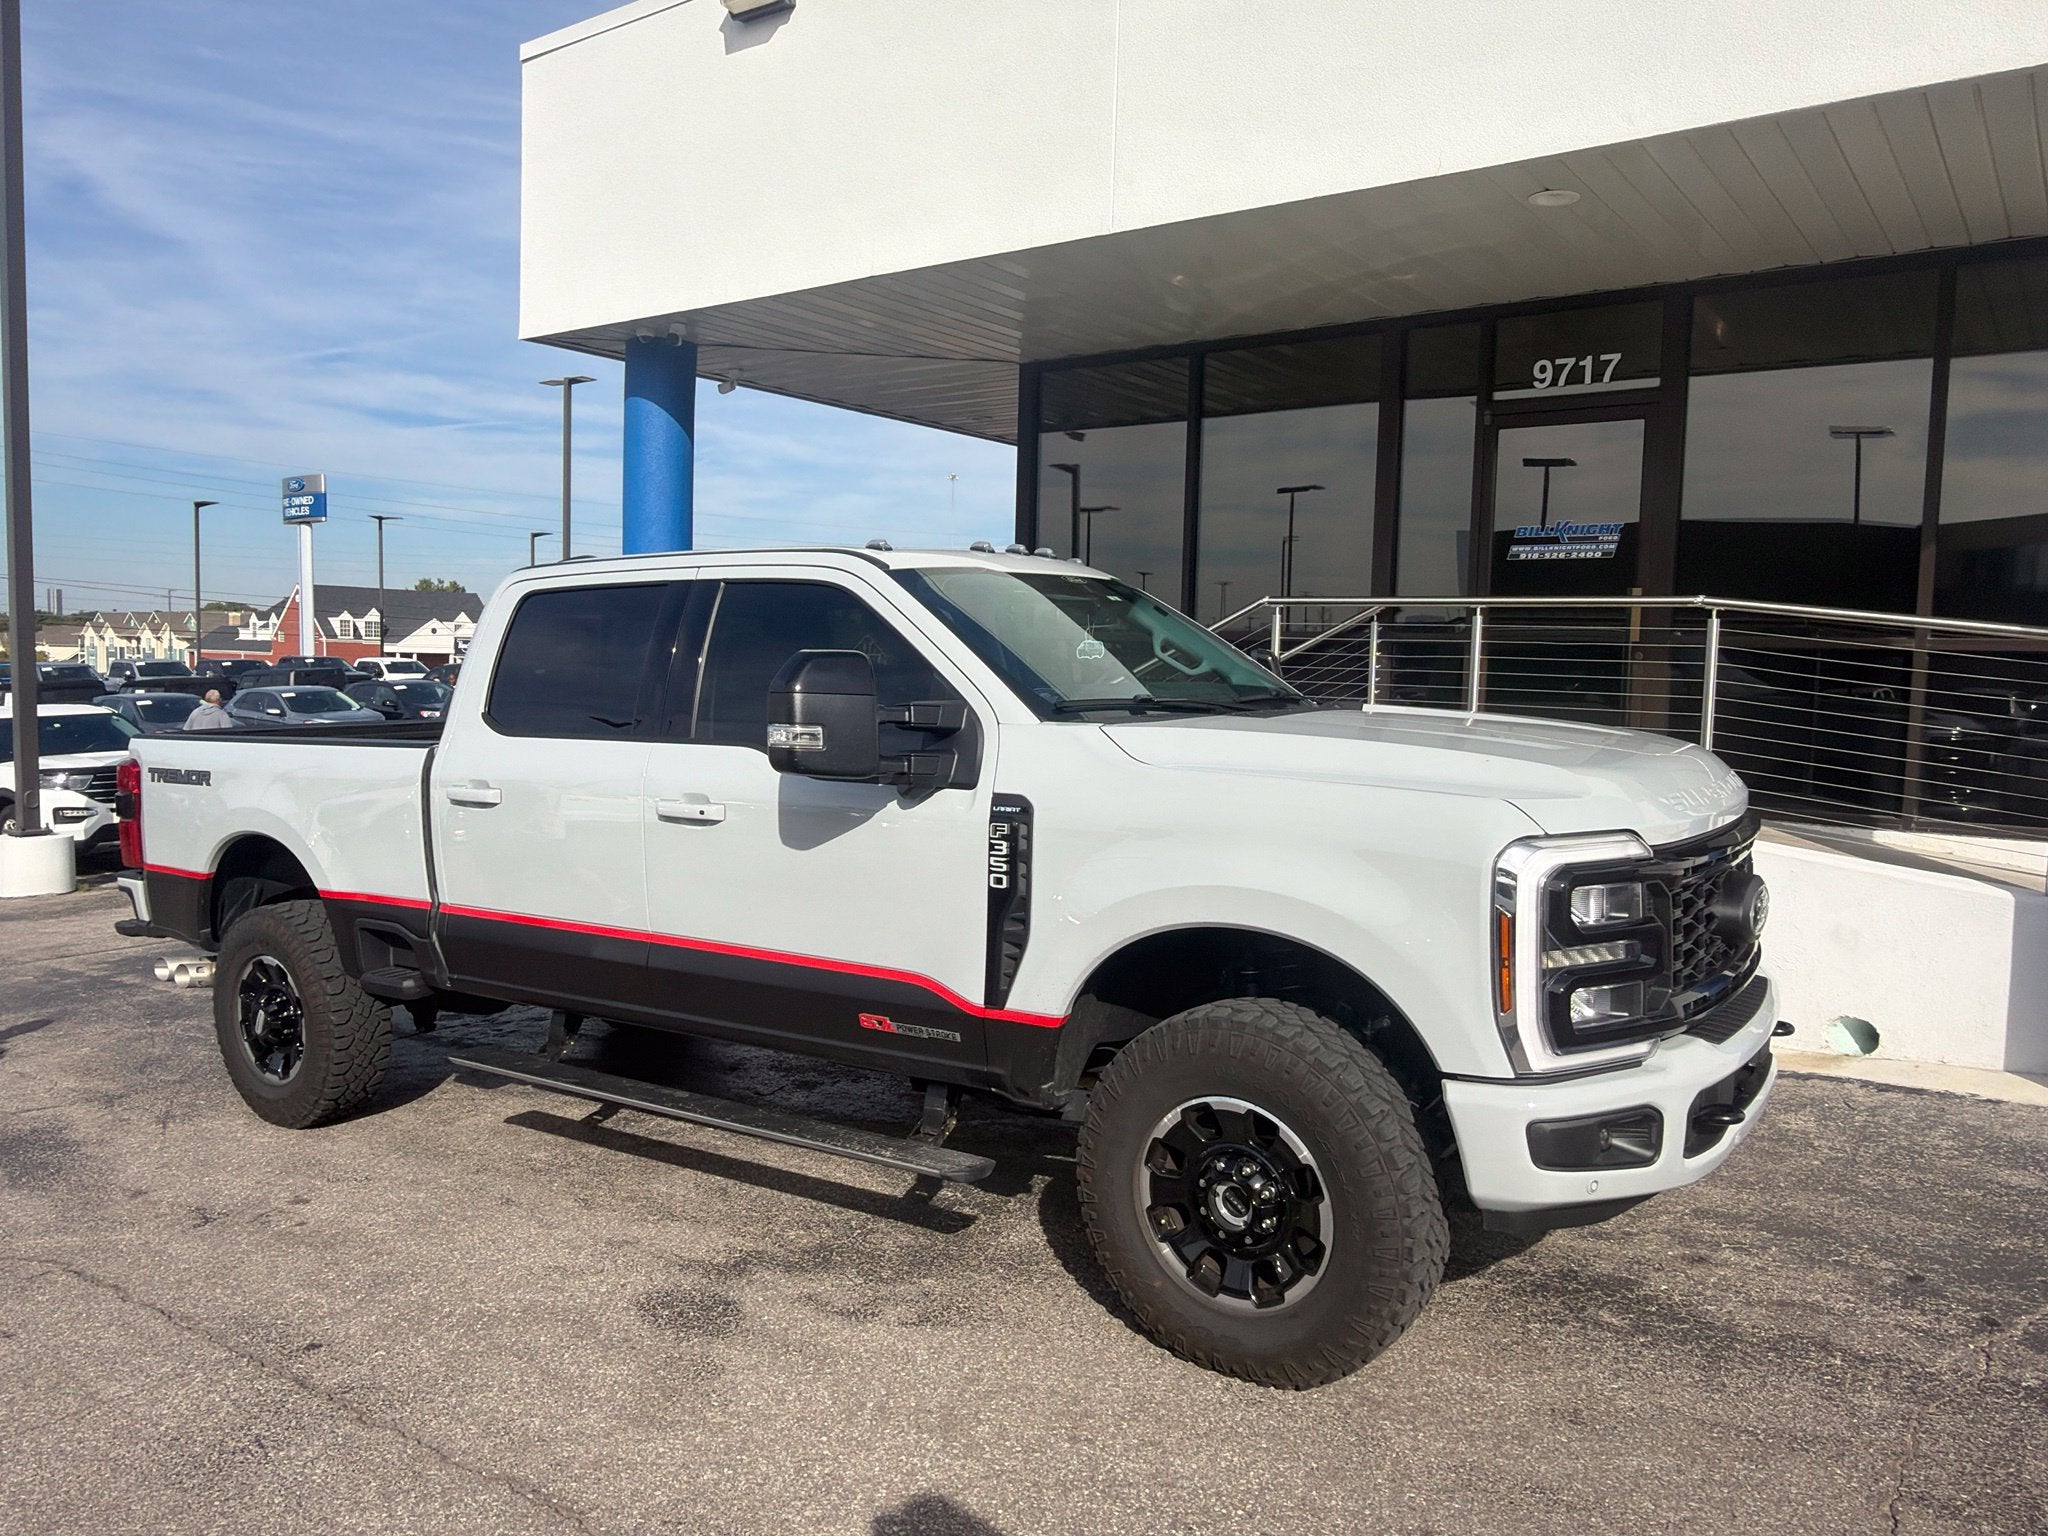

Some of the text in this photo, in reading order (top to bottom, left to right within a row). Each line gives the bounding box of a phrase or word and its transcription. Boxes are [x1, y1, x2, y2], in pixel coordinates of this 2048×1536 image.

[1533, 353, 1622, 389] 9717
[1520, 551, 1602, 559] 918-526-2400
[148, 767, 211, 786] TREMOR
[989, 822, 1010, 889] F350
[896, 1023, 925, 1036] POWER
[925, 1028, 959, 1041] STROKE
